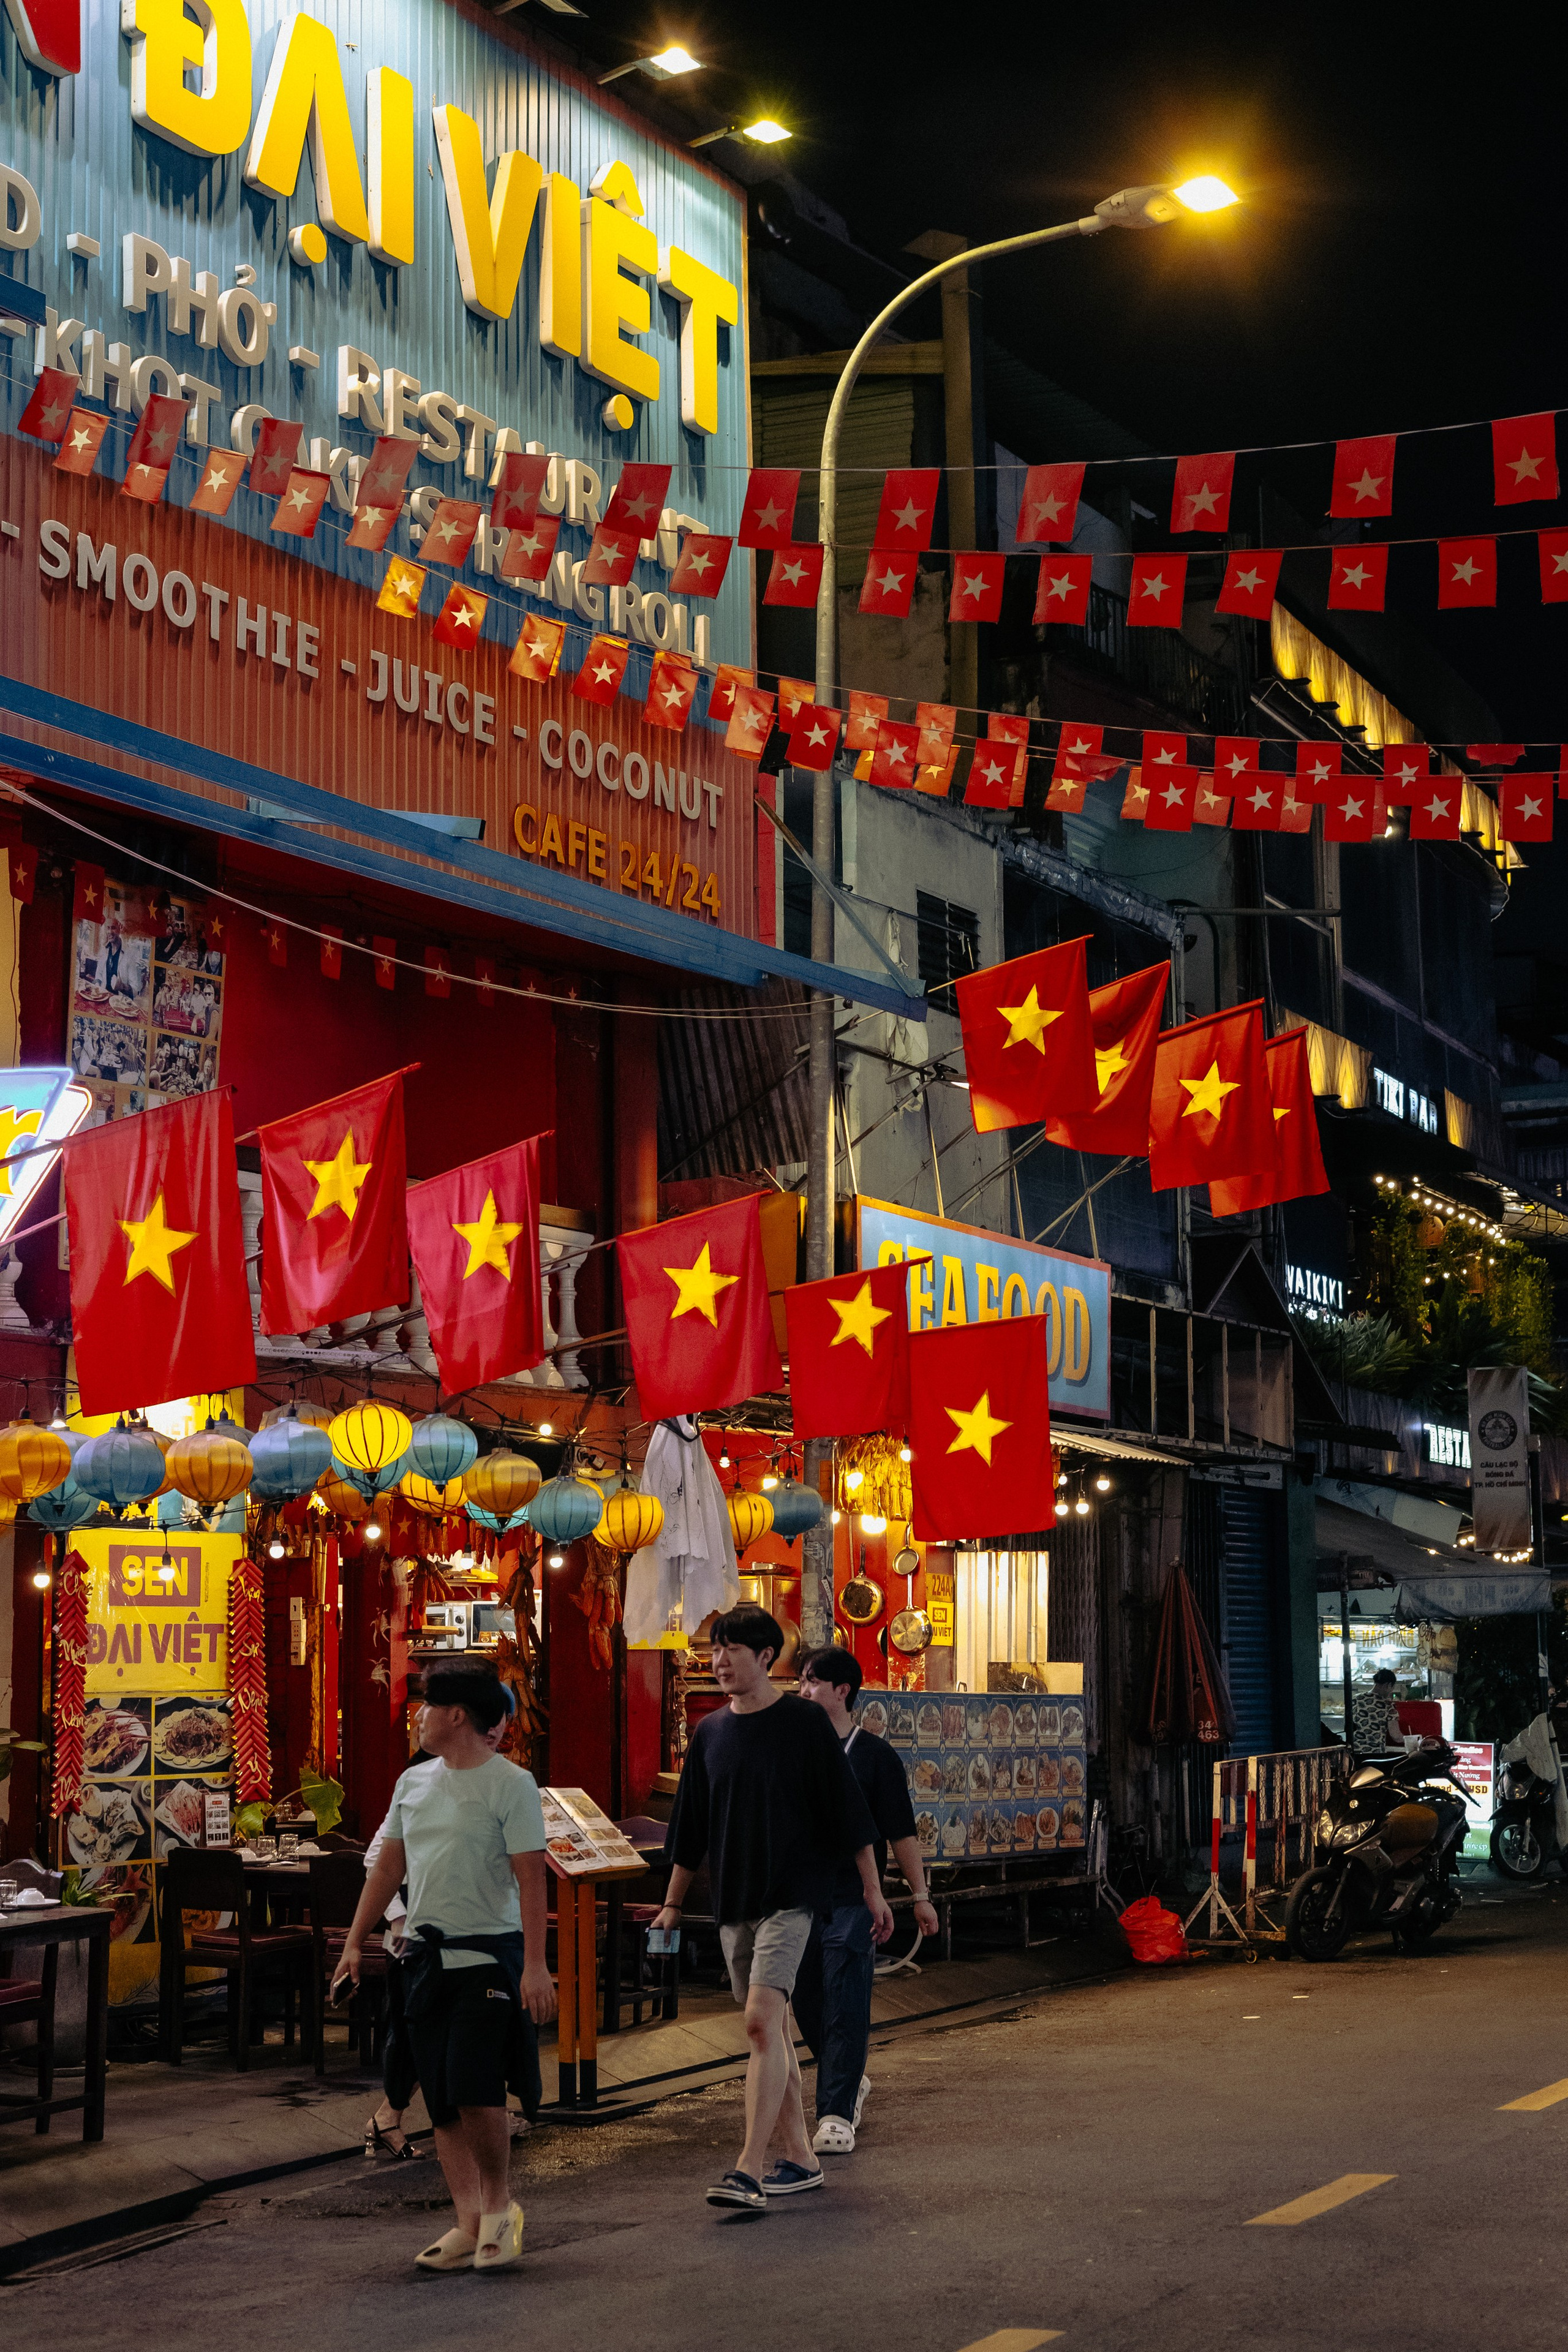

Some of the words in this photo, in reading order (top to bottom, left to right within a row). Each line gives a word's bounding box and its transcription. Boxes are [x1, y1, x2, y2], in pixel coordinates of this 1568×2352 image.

[122, 0, 413, 267] ĐẠI
[433, 104, 738, 435] VIỆT
[123, 232, 277, 367] PHỞ
[338, 345, 709, 570] RESTAURNT
[610, 581, 719, 677] ROLL
[39, 519, 319, 679] SMOOTHIE
[367, 650, 495, 745] JUICE
[540, 719, 723, 828] COCONUT
[513, 803, 607, 878] CAFE
[620, 841, 722, 917] 24/24
[1374, 1067, 1404, 1119] TIKI
[1409, 1088, 1438, 1135] BAR
[877, 1239, 1093, 1387] EAFOD
[121, 1555, 189, 1596] SEN
[932, 1574, 951, 1596] 224A
[86, 1623, 141, 1677] ĐẠI
[148, 1611, 224, 1676] VIỆT
[933, 1608, 946, 1621] SEN
[938, 1624, 951, 1640] VIỆT
[1197, 1730, 1219, 1740] 463
